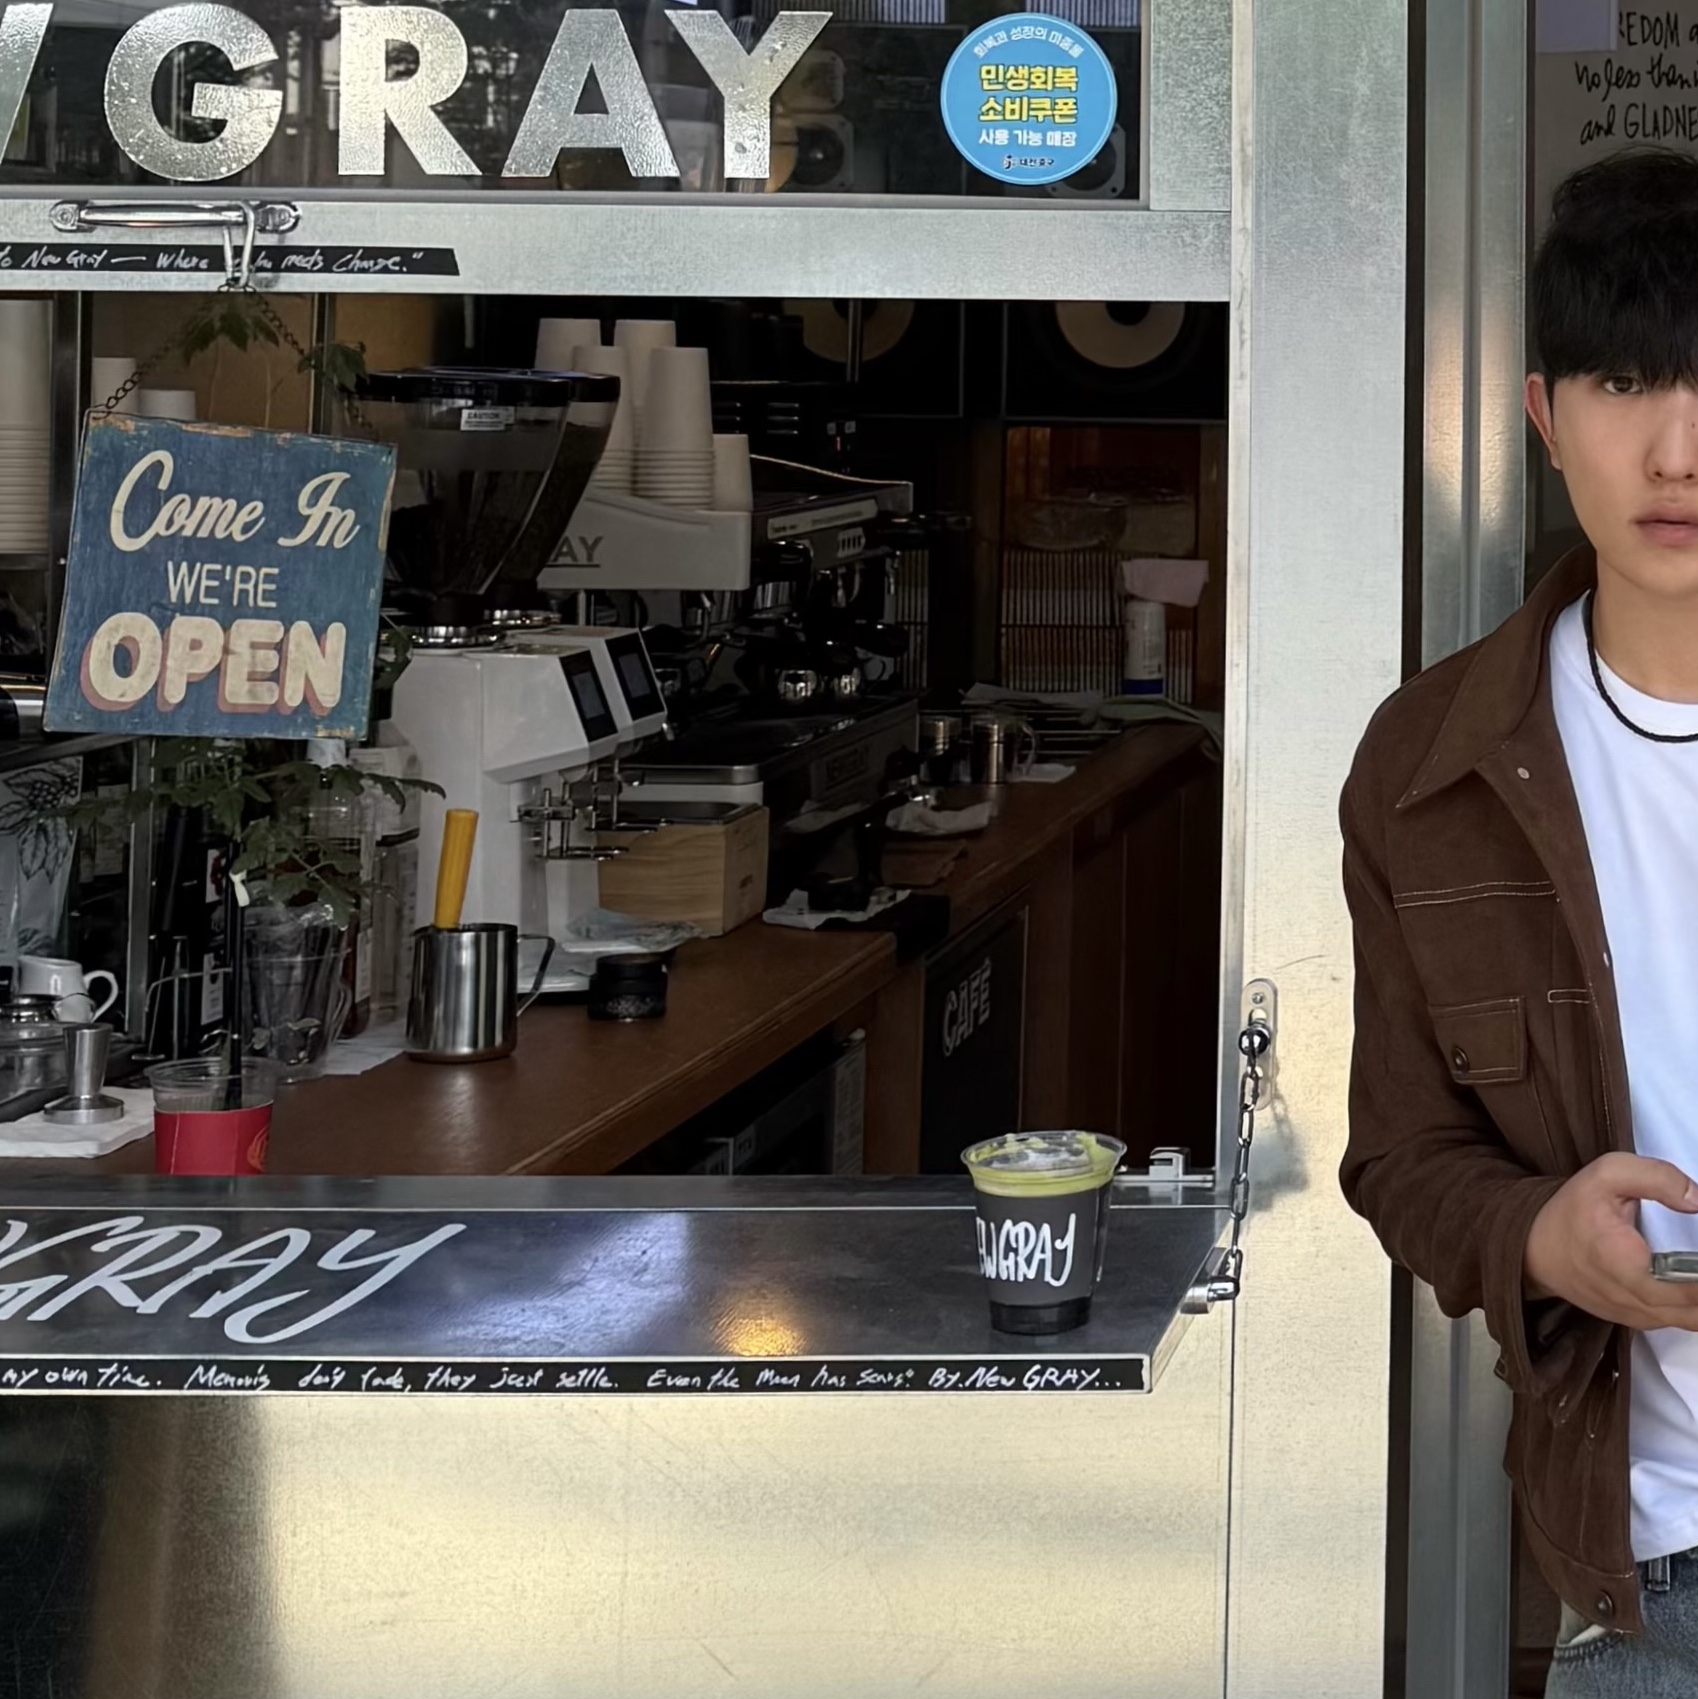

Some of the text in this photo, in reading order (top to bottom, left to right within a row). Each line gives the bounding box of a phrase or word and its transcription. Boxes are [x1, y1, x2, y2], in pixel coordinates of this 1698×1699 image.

[1010, 25, 1048, 41] 성장의
[979, 63, 1078, 92] 민생회복
[1647, 53, 1692, 90] than
[0, 2, 834, 181] GRAY
[978, 96, 1078, 124] 소비쿠폰
[1580, 104, 1616, 146] and
[979, 128, 1077, 147] 사용 가능 매장
[156, 248, 209, 269] Where
[110, 449, 361, 552] Come In
[167, 560, 280, 608] WE'RE
[81, 611, 347, 716] OPEN
[45, 1367, 88, 1386] own
[425, 1365, 476, 1390] they
[707, 1367, 740, 1390] the
[811, 1365, 846, 1387] has
